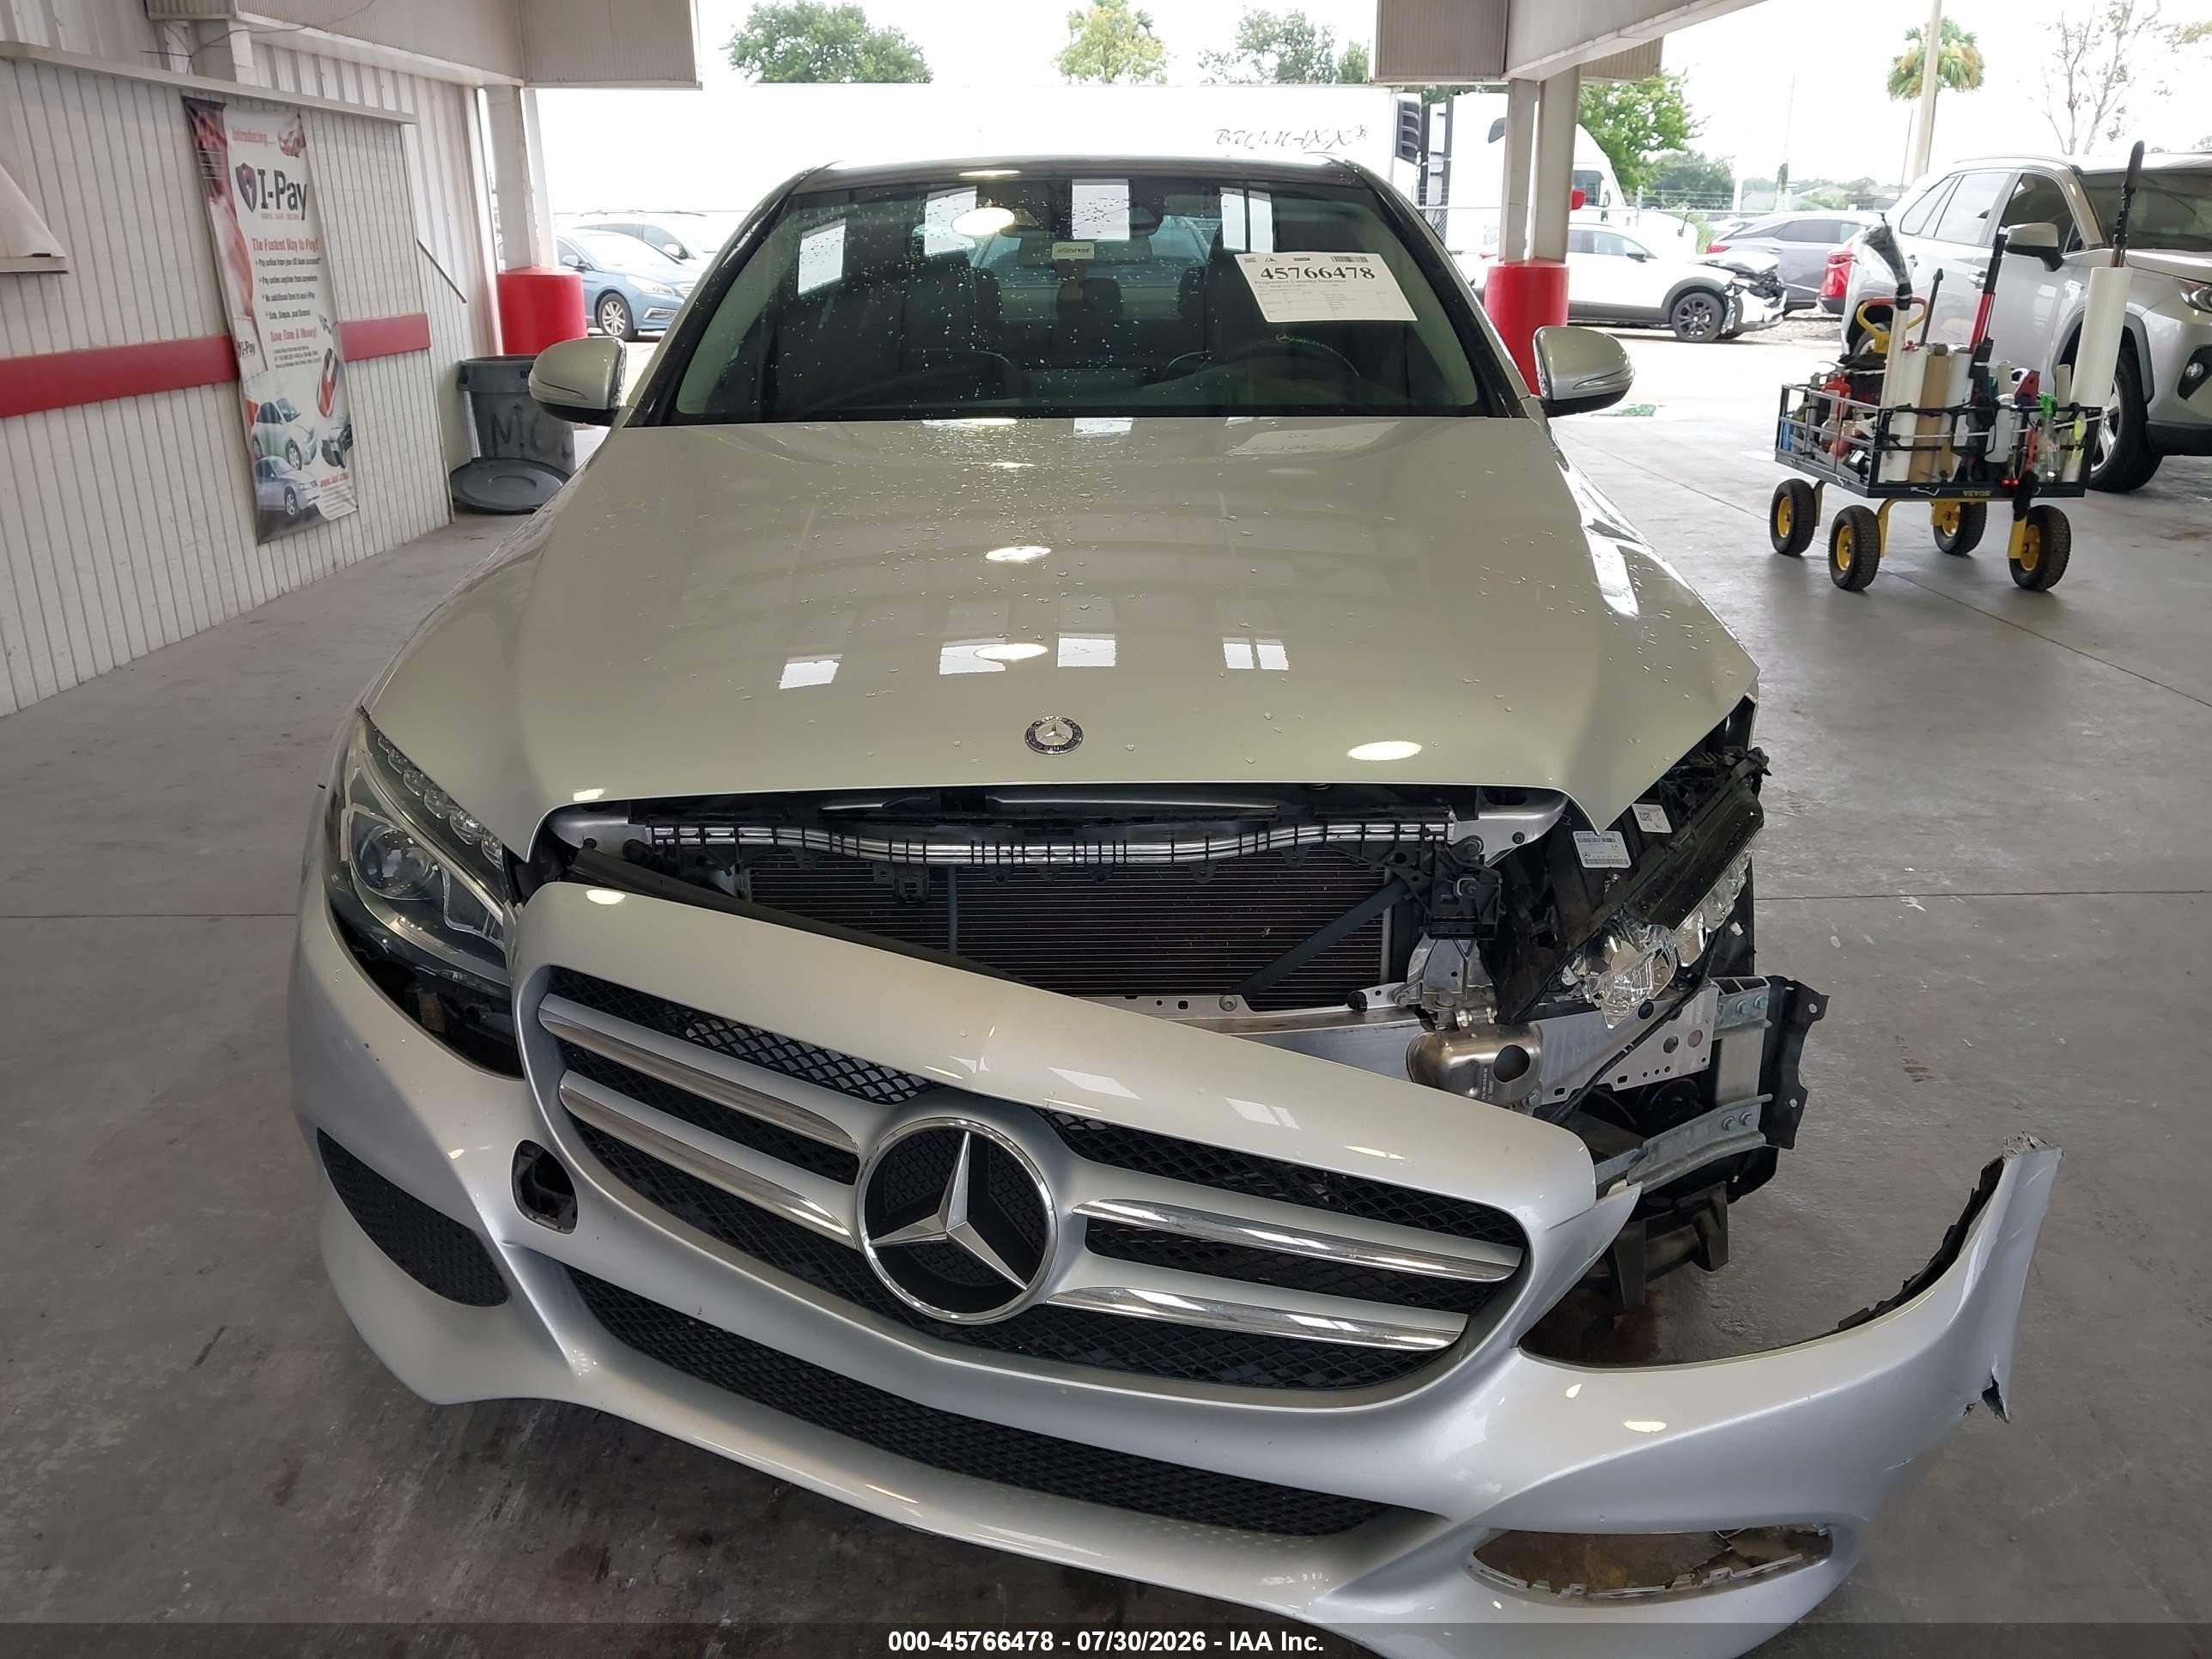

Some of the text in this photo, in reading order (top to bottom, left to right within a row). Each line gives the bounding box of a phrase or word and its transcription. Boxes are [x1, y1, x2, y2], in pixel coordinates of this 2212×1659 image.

[257, 168, 307, 221] I-Pay
[252, 238, 264, 252] The
[264, 238, 286, 252] Fastest
[1260, 266, 1376, 280] 45766478
